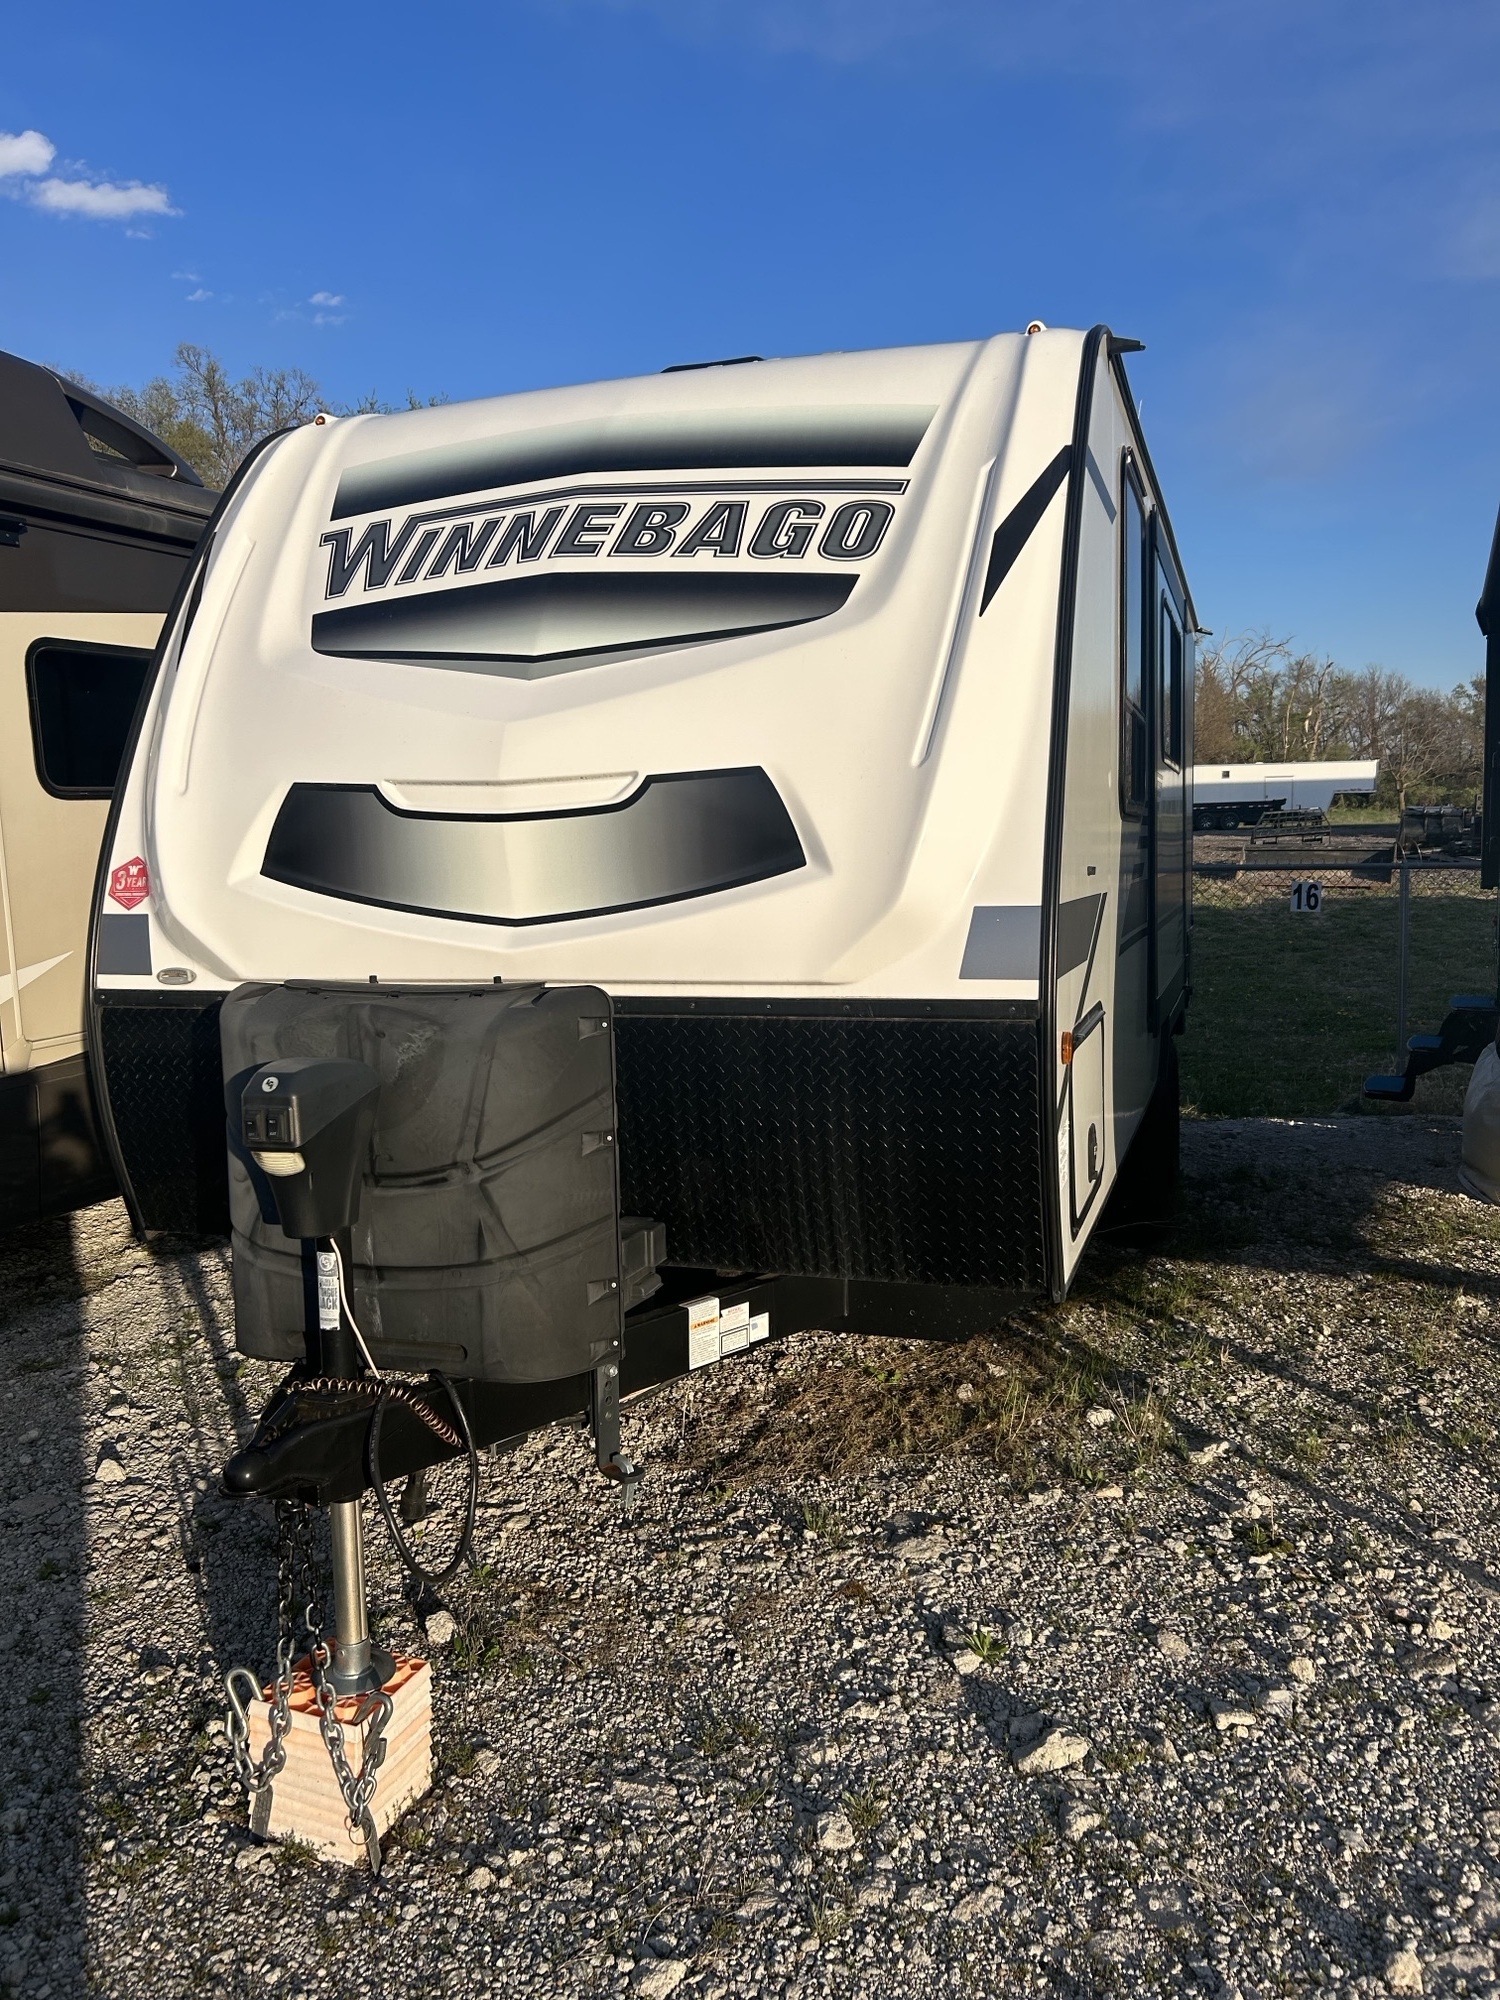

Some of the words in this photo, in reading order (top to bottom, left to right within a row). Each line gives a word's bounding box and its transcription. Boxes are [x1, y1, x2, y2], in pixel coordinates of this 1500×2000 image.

[319, 498, 897, 600] WINNEBAGO
[115, 870, 127, 890] 3
[126, 876, 147, 888] YEAR
[1293, 883, 1319, 910] 16
